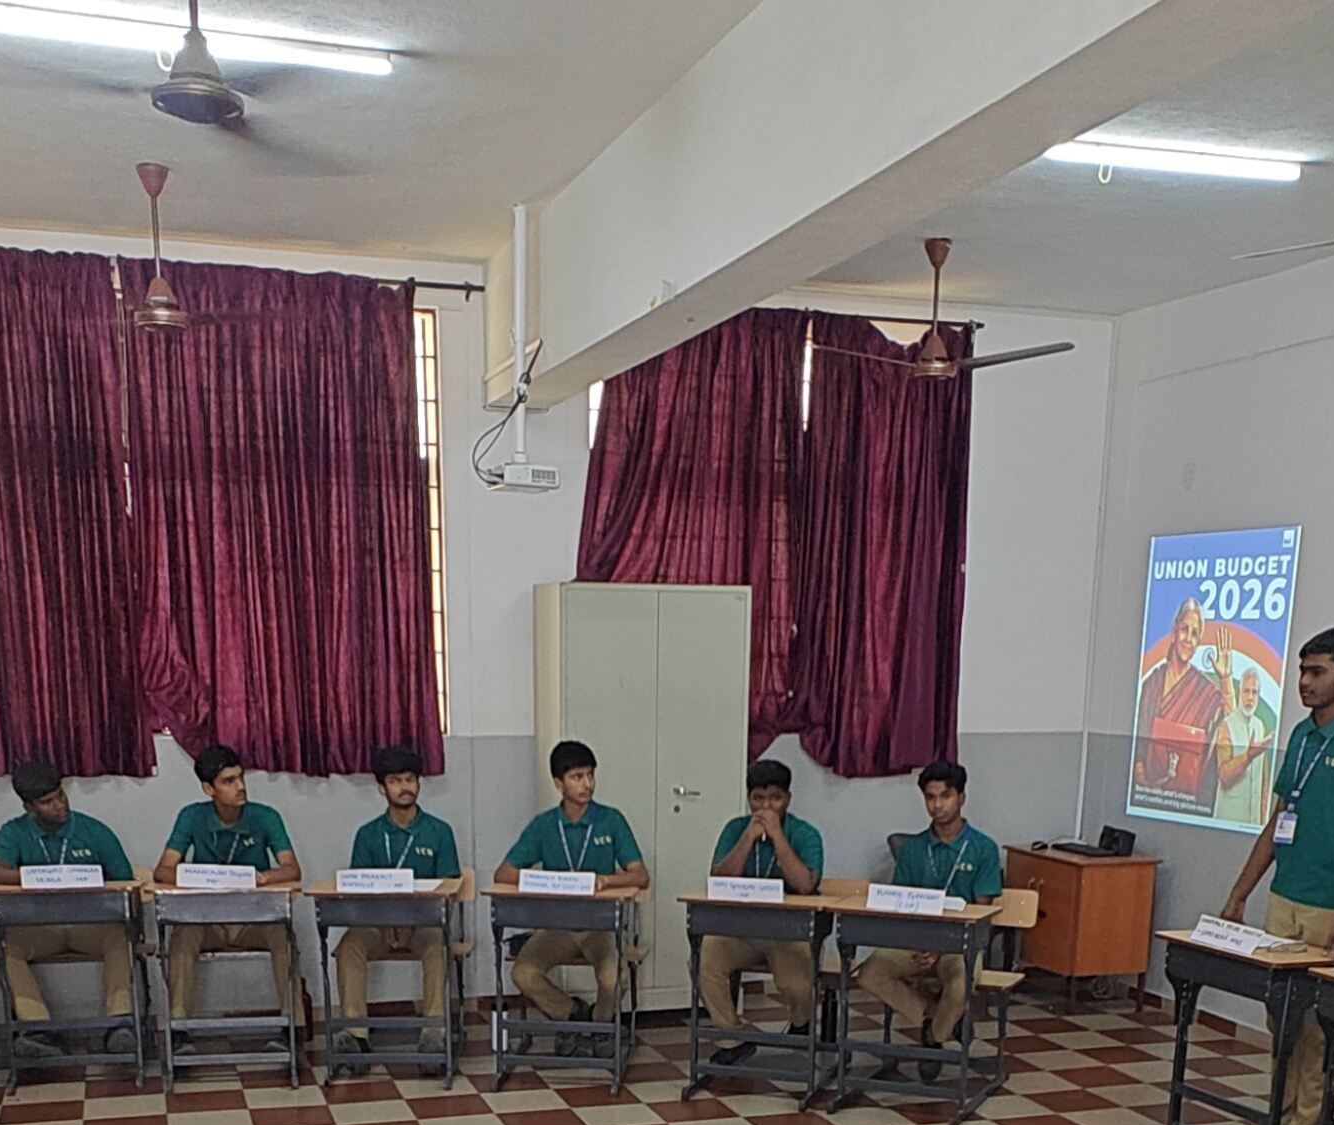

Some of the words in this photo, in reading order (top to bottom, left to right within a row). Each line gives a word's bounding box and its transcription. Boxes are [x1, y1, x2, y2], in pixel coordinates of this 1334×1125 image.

[1154, 559, 1208, 579] UNION
[1214, 555, 1291, 577] BUDGET
[1199, 577, 1287, 620] 2026
